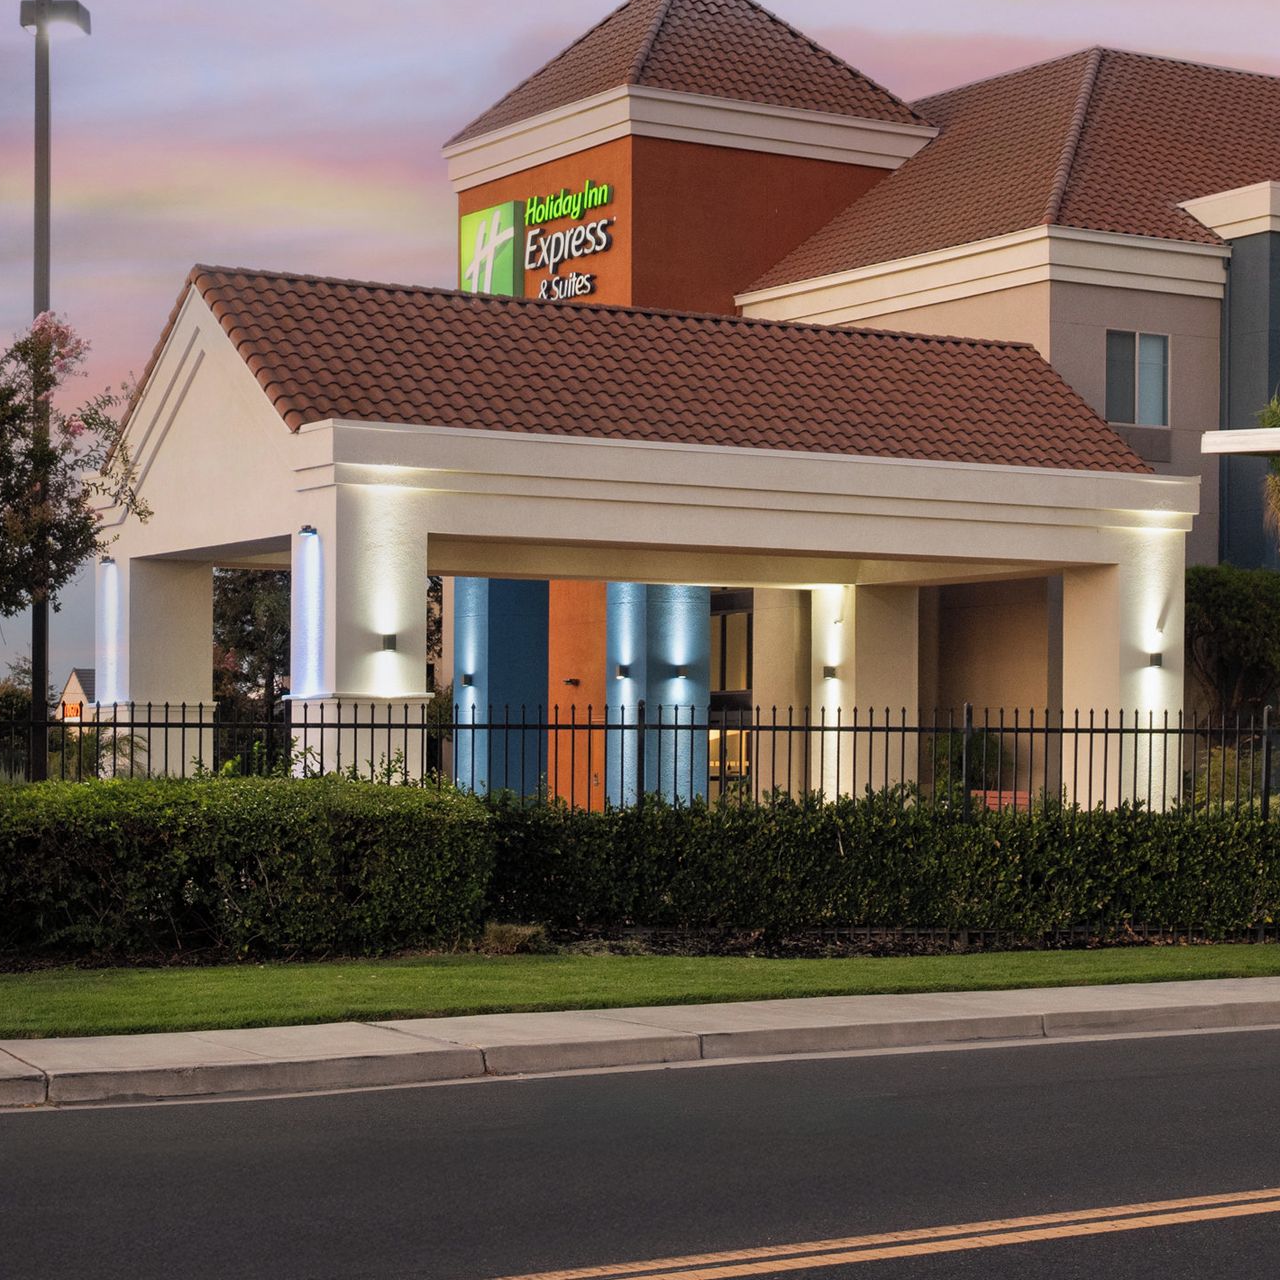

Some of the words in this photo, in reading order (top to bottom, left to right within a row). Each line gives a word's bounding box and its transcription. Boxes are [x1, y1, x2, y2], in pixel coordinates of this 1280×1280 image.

[524, 188, 583, 226] Holiday
[583, 179, 609, 209] Inn
[524, 219, 609, 273] Express
[538, 279, 549, 299] &
[550, 272, 591, 301] Suites
